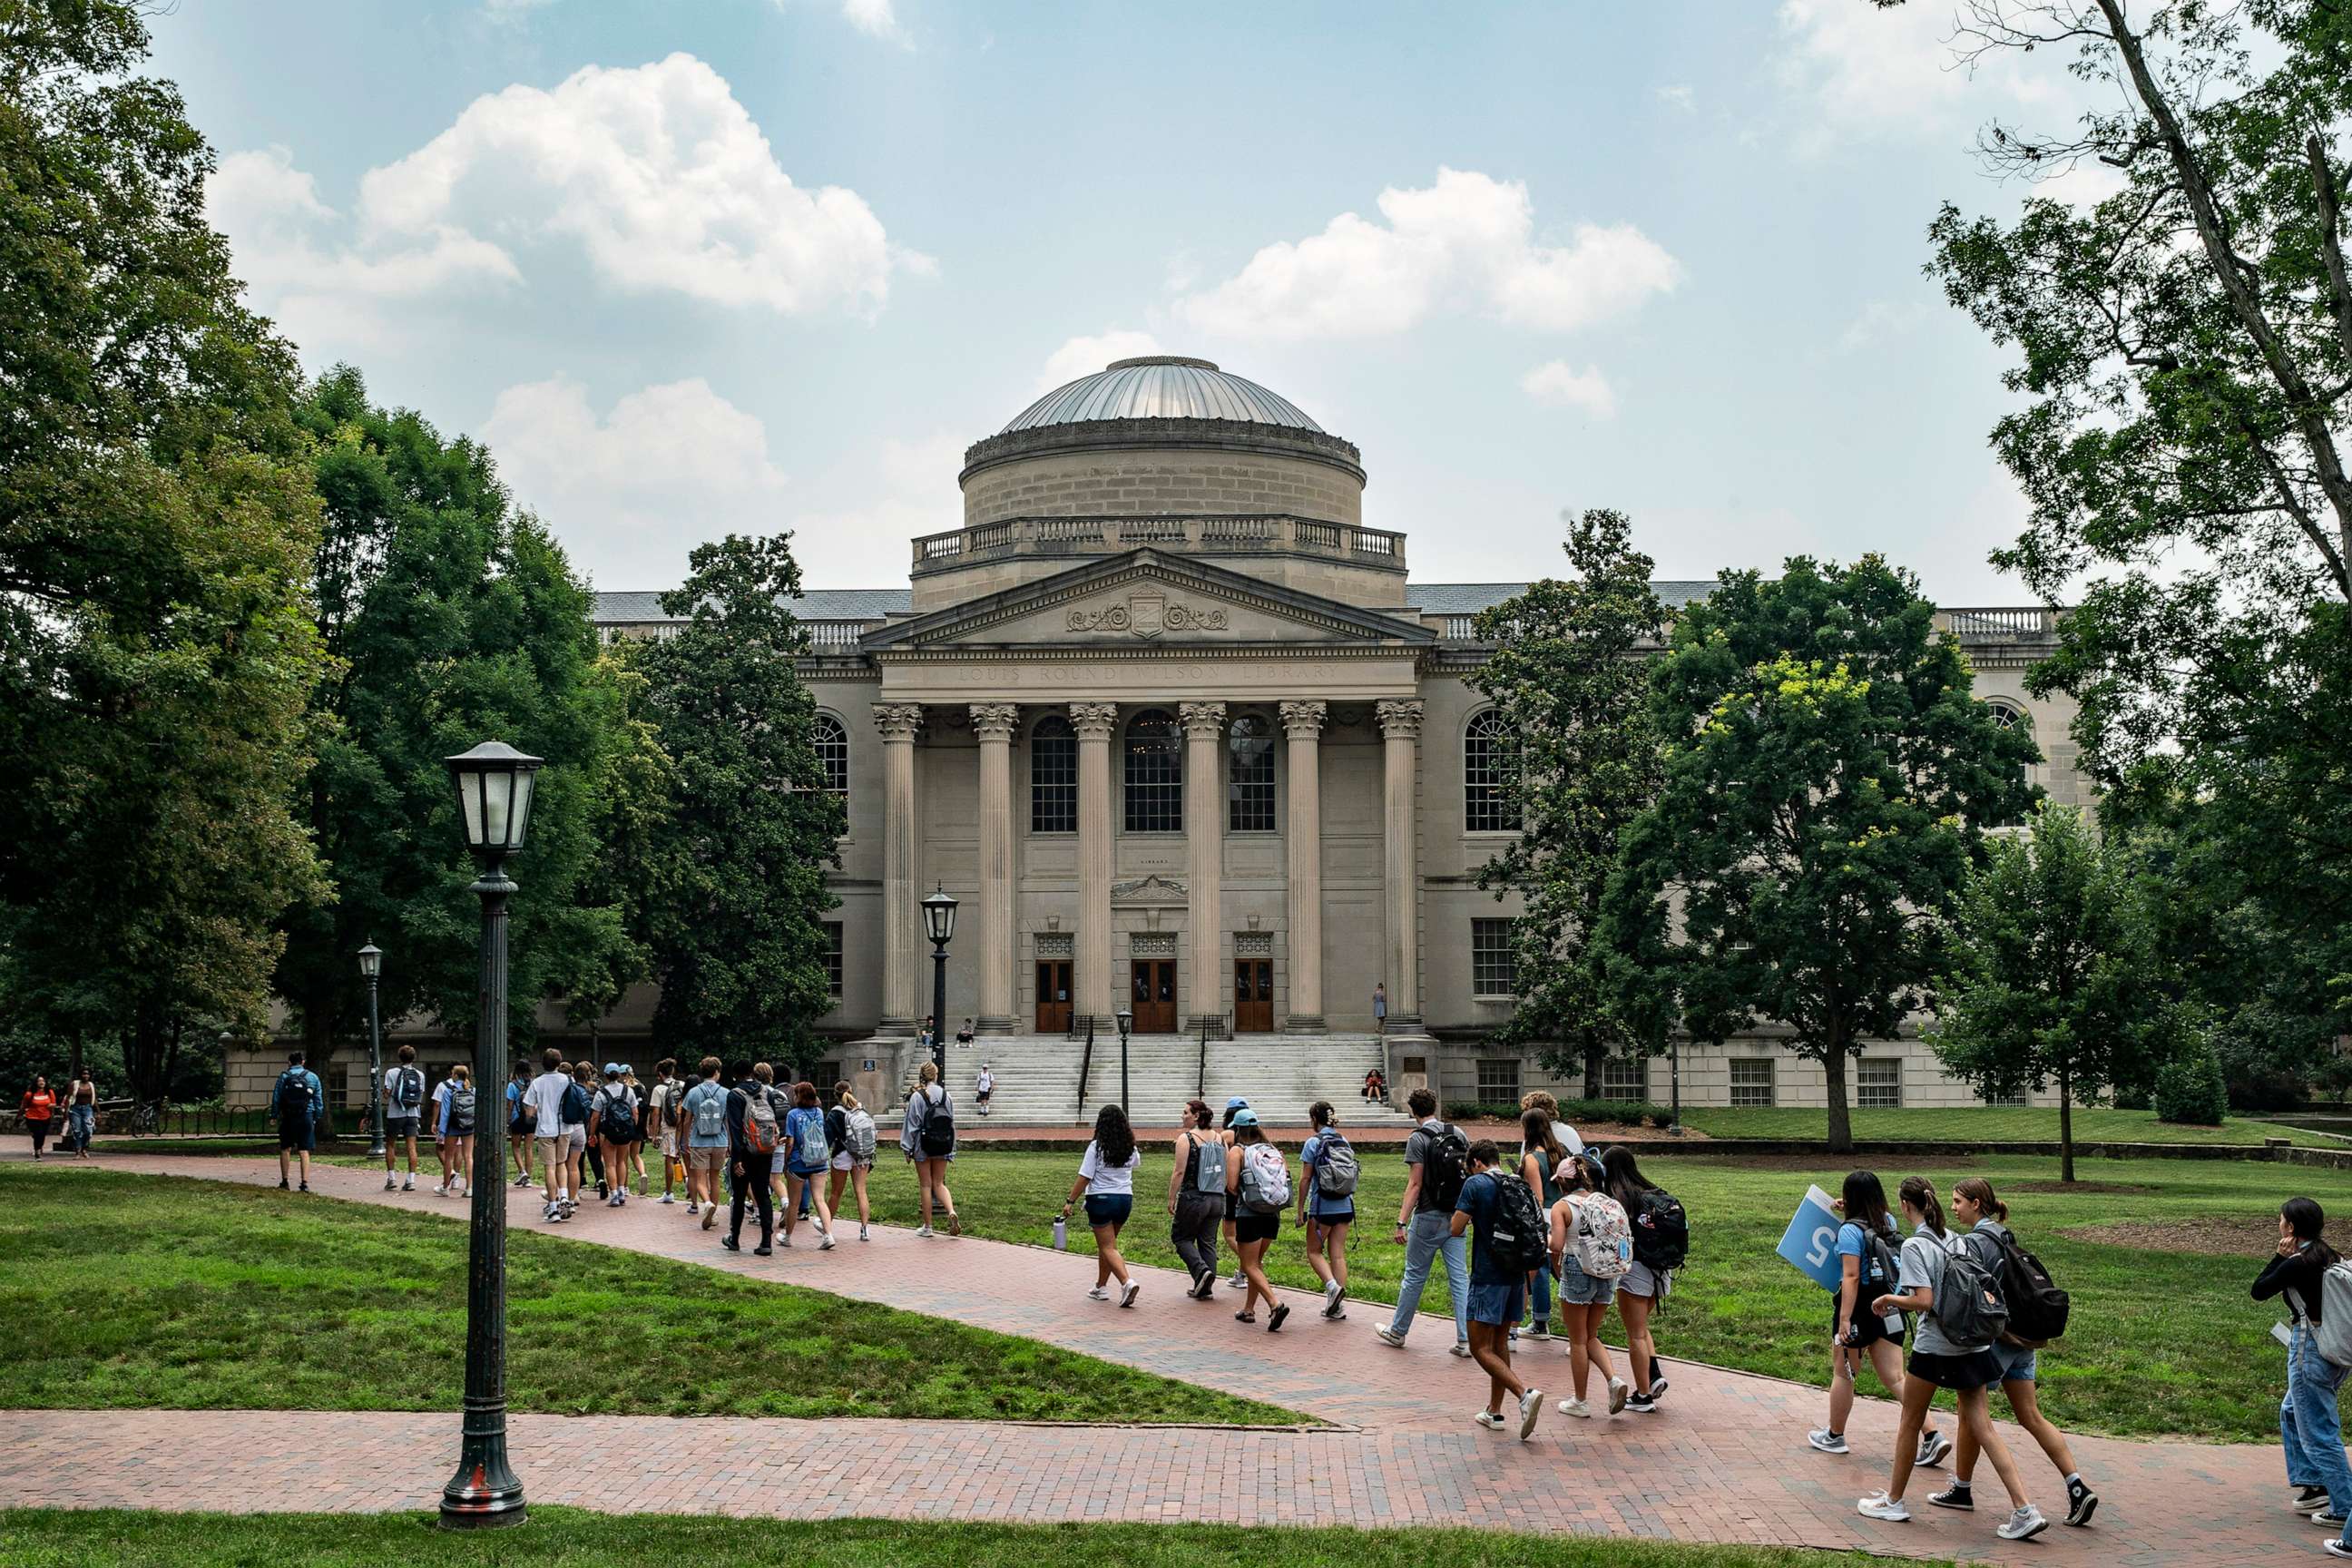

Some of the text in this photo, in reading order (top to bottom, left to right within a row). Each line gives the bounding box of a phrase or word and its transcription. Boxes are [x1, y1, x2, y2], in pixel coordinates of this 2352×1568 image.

[959, 665, 1338, 681] LOUIS ROUND WILSON LIBRARY
[1806, 1226, 1837, 1269] 5
